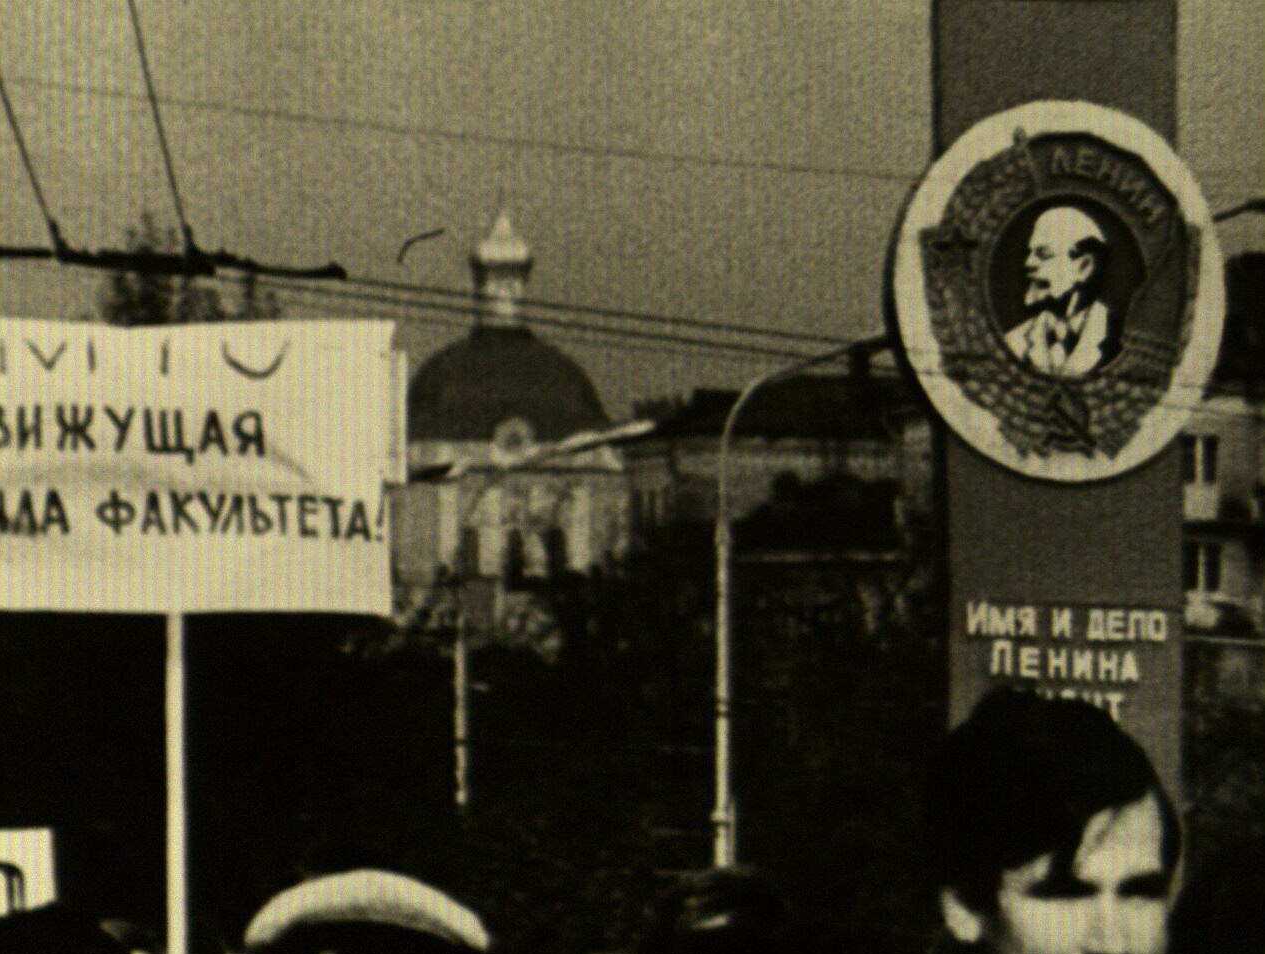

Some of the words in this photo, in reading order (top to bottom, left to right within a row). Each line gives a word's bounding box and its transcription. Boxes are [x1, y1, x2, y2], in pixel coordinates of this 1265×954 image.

[95, 490, 385, 543] ФАКУЛЬТЕТА!
[966, 601, 1036, 637] ИМЯ
[1051, 607, 1073, 638] И
